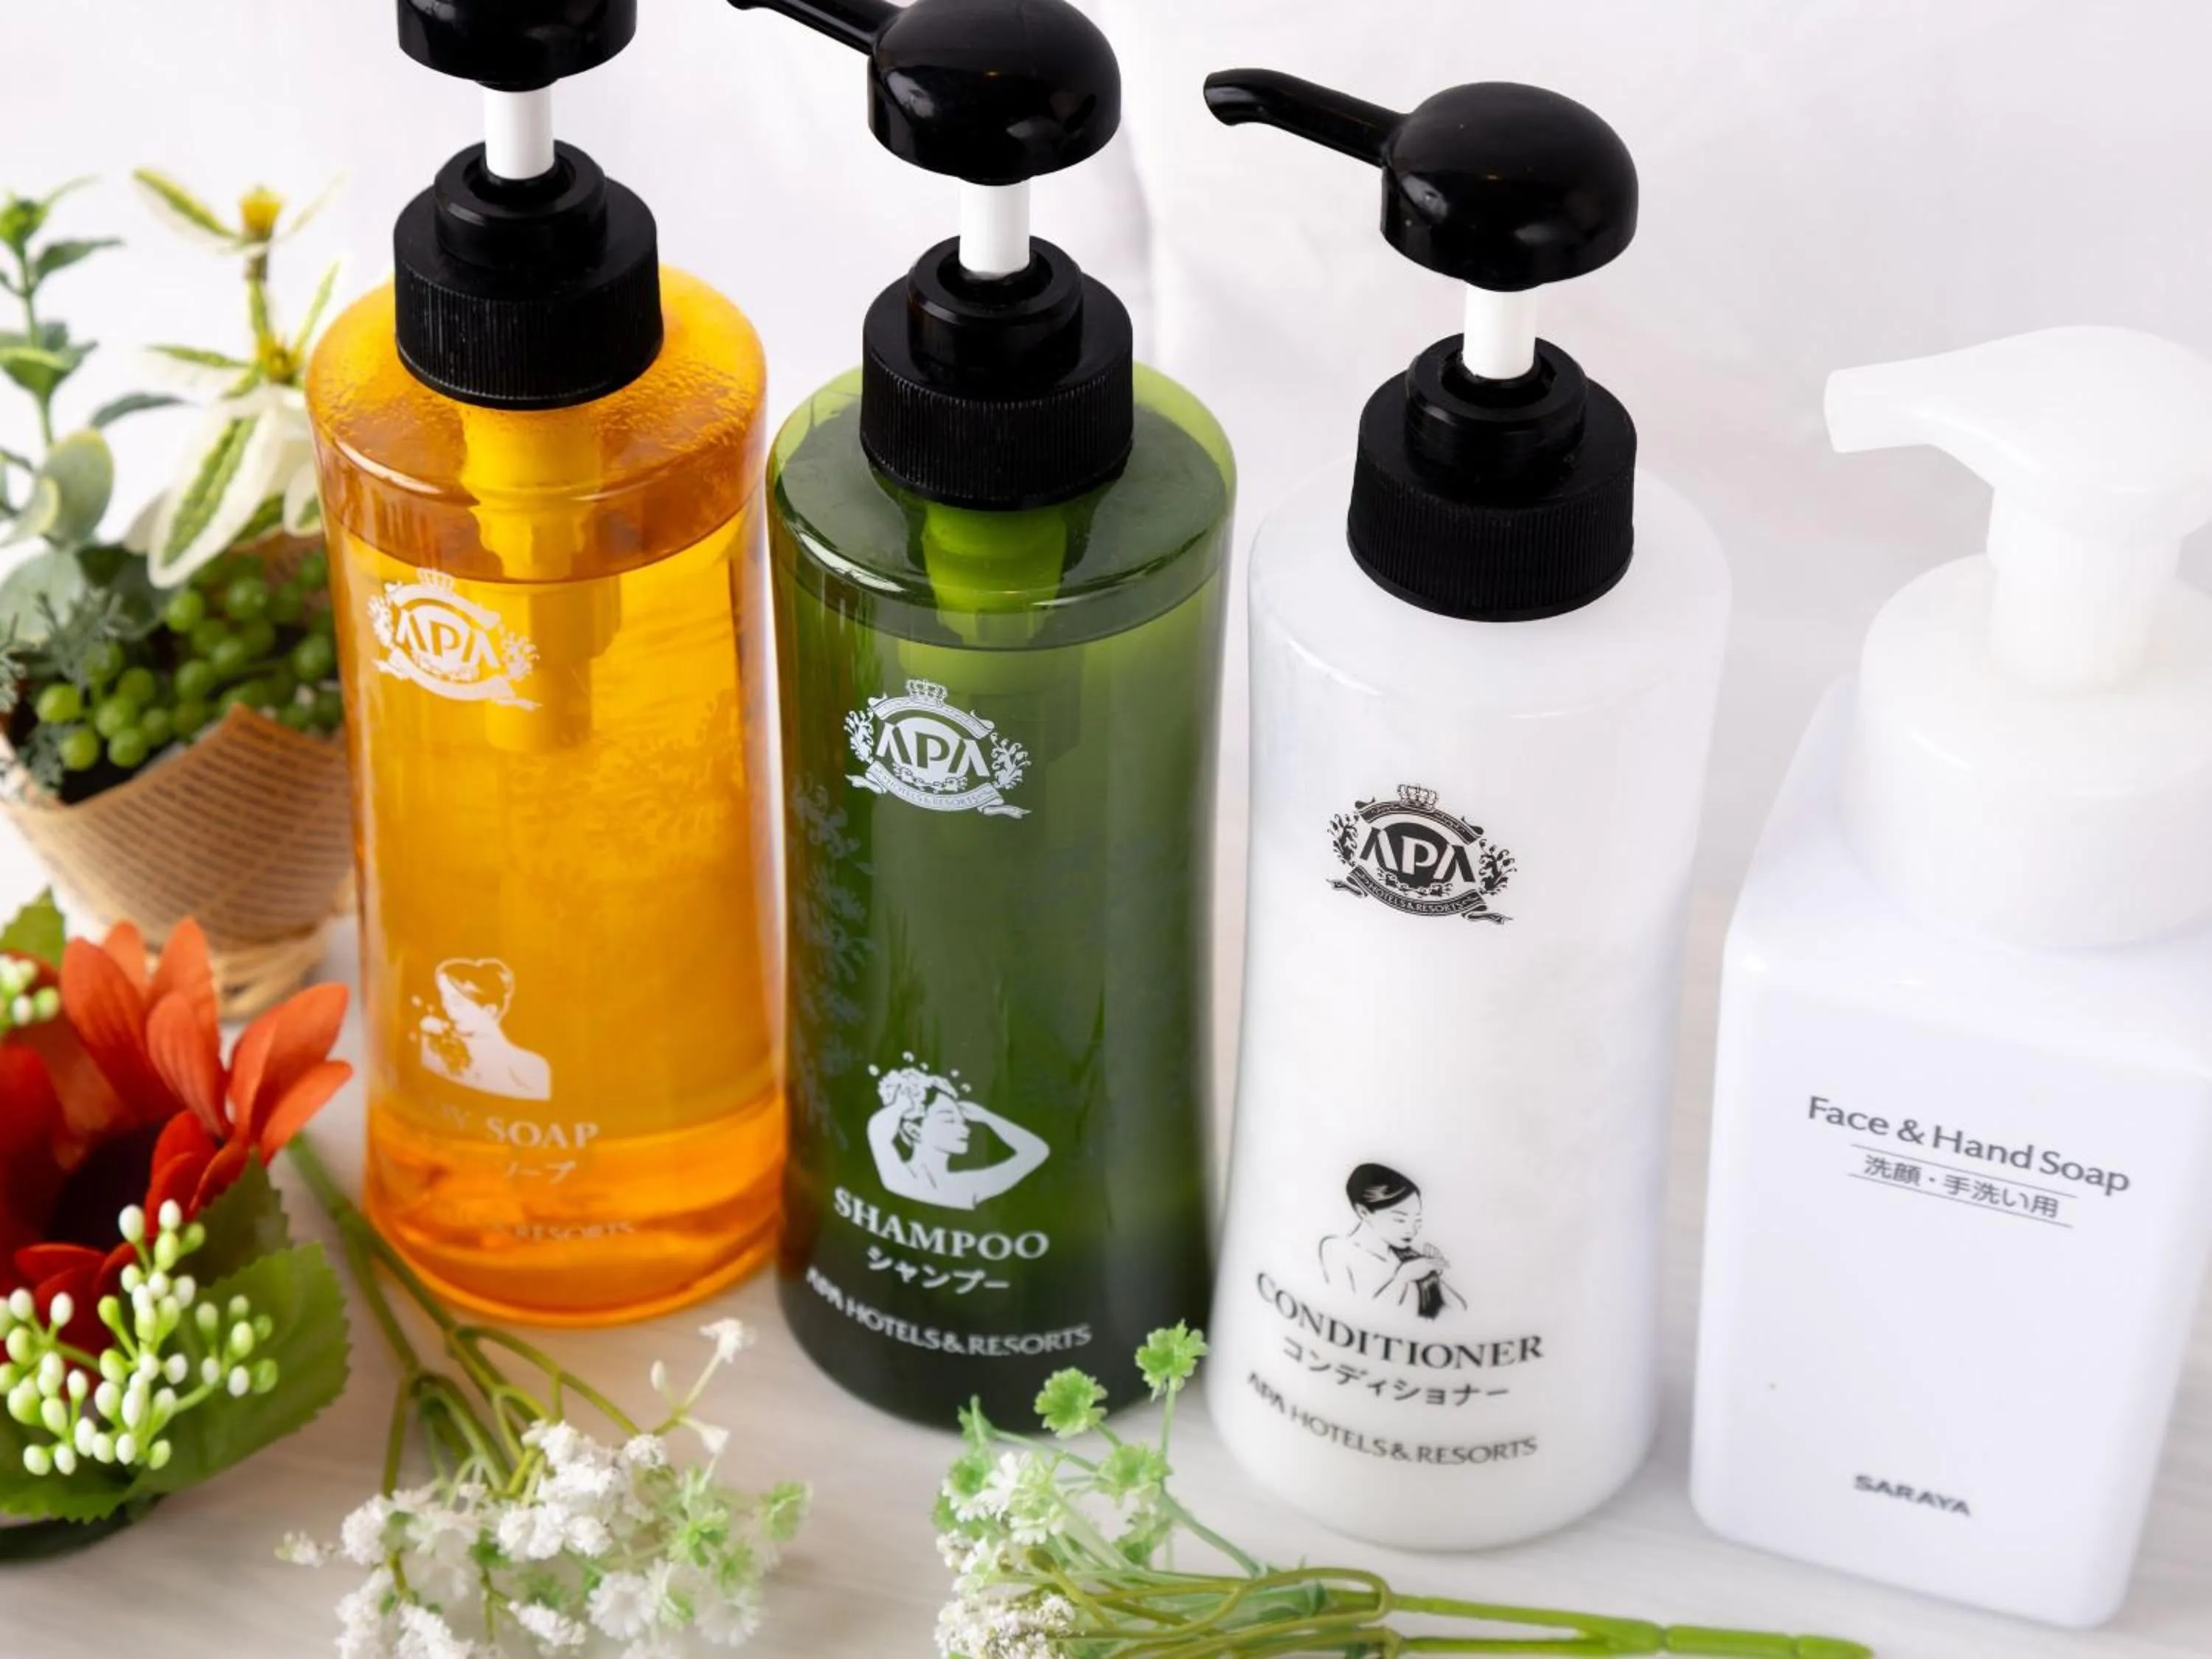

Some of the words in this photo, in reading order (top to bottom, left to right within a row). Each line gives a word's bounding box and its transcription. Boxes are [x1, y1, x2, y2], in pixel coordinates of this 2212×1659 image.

[394, 608, 501, 668] APA
[875, 722, 990, 776] APA
[1359, 826, 1476, 883] APA
[485, 1116, 599, 1150] SOAP
[1807, 1096, 1890, 1135] Face
[1896, 1119, 1925, 1146] &
[1932, 1124, 2034, 1169] Hand
[2039, 1150, 2130, 1196] Soap
[1863, 1154, 2059, 1218] 洗顔・手洗い用
[833, 1186, 1050, 1260] SHAMPOO
[867, 1244, 1010, 1294] シャンプー
[1256, 1271, 1545, 1370] CONDITIONER
[1282, 1336, 1510, 1408] コンディショナー
[1853, 1475, 1972, 1517] SARAYA
